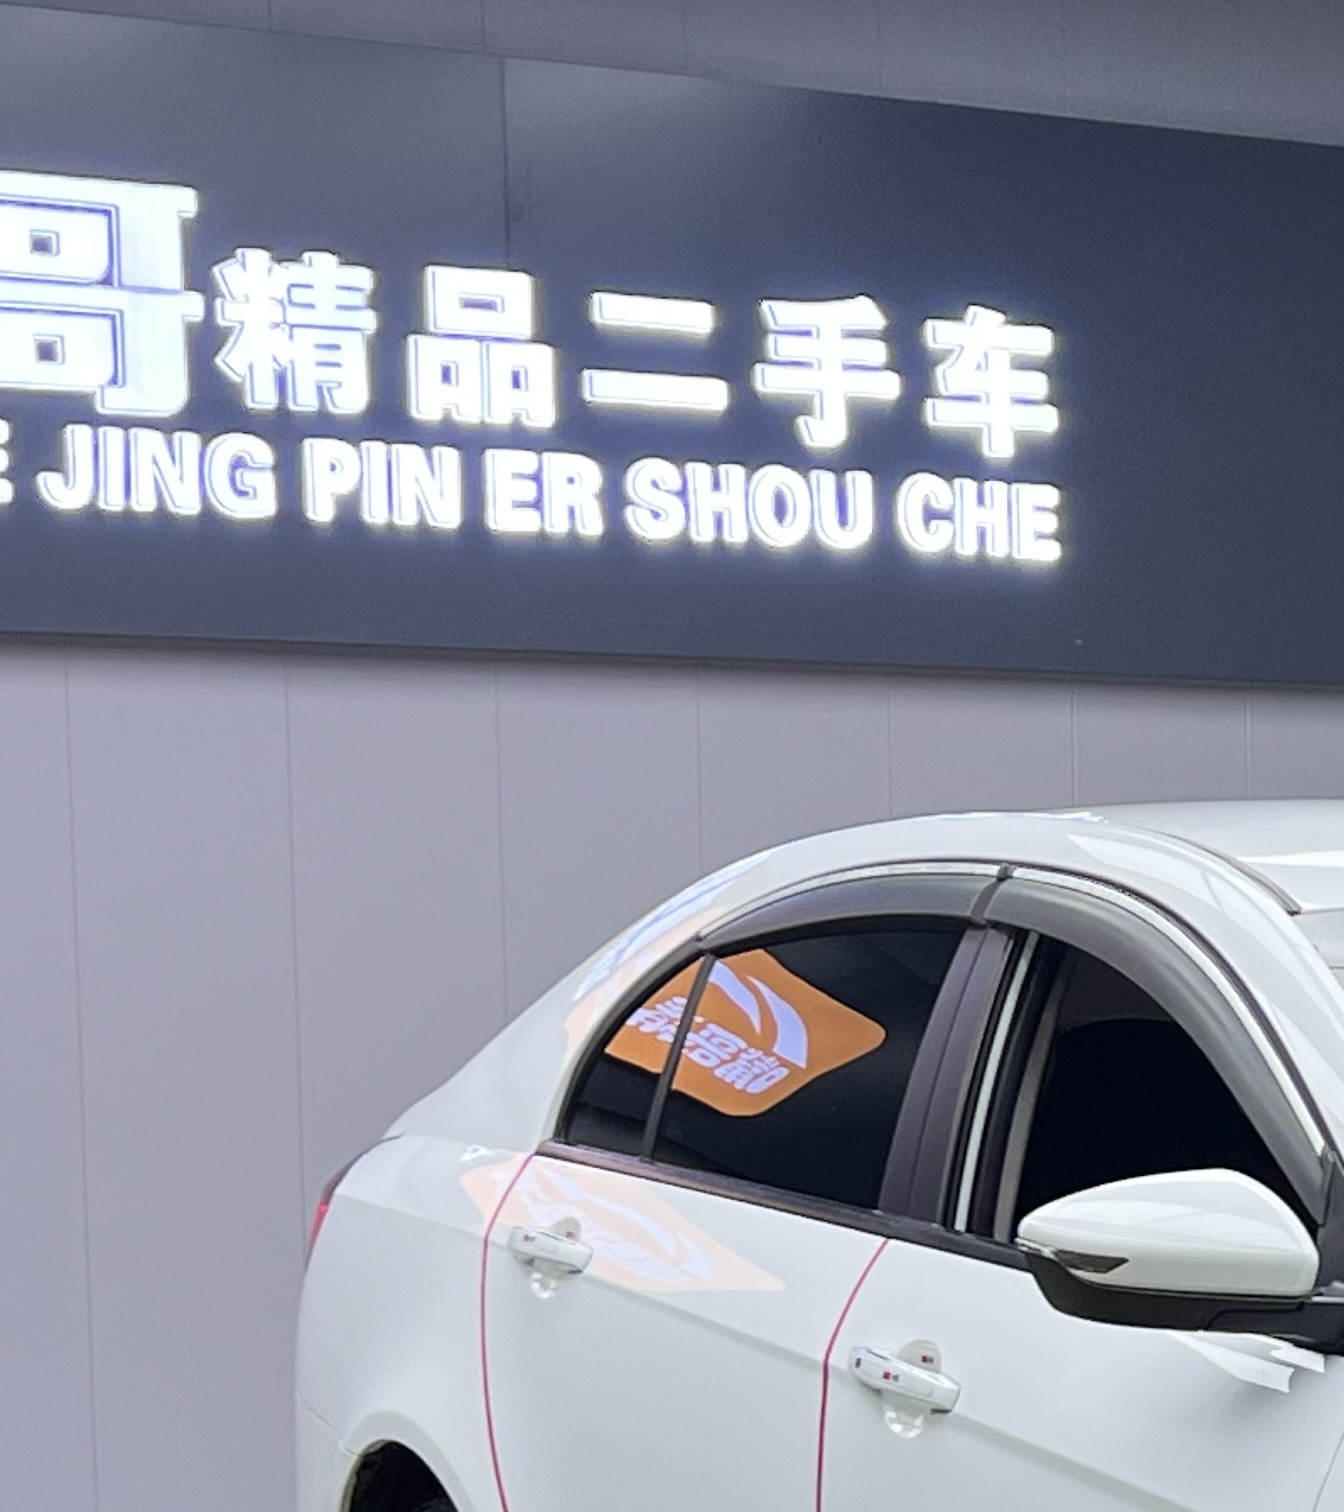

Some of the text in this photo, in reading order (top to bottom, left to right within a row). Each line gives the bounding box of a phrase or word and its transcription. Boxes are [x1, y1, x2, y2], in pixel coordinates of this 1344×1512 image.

[211, 246, 1060, 461] 精品二手车
[35, 422, 278, 520] JING
[302, 437, 463, 530] PIN
[483, 447, 605, 538] ER
[624, 457, 875, 551] SHOU
[895, 471, 1063, 564] CHE
